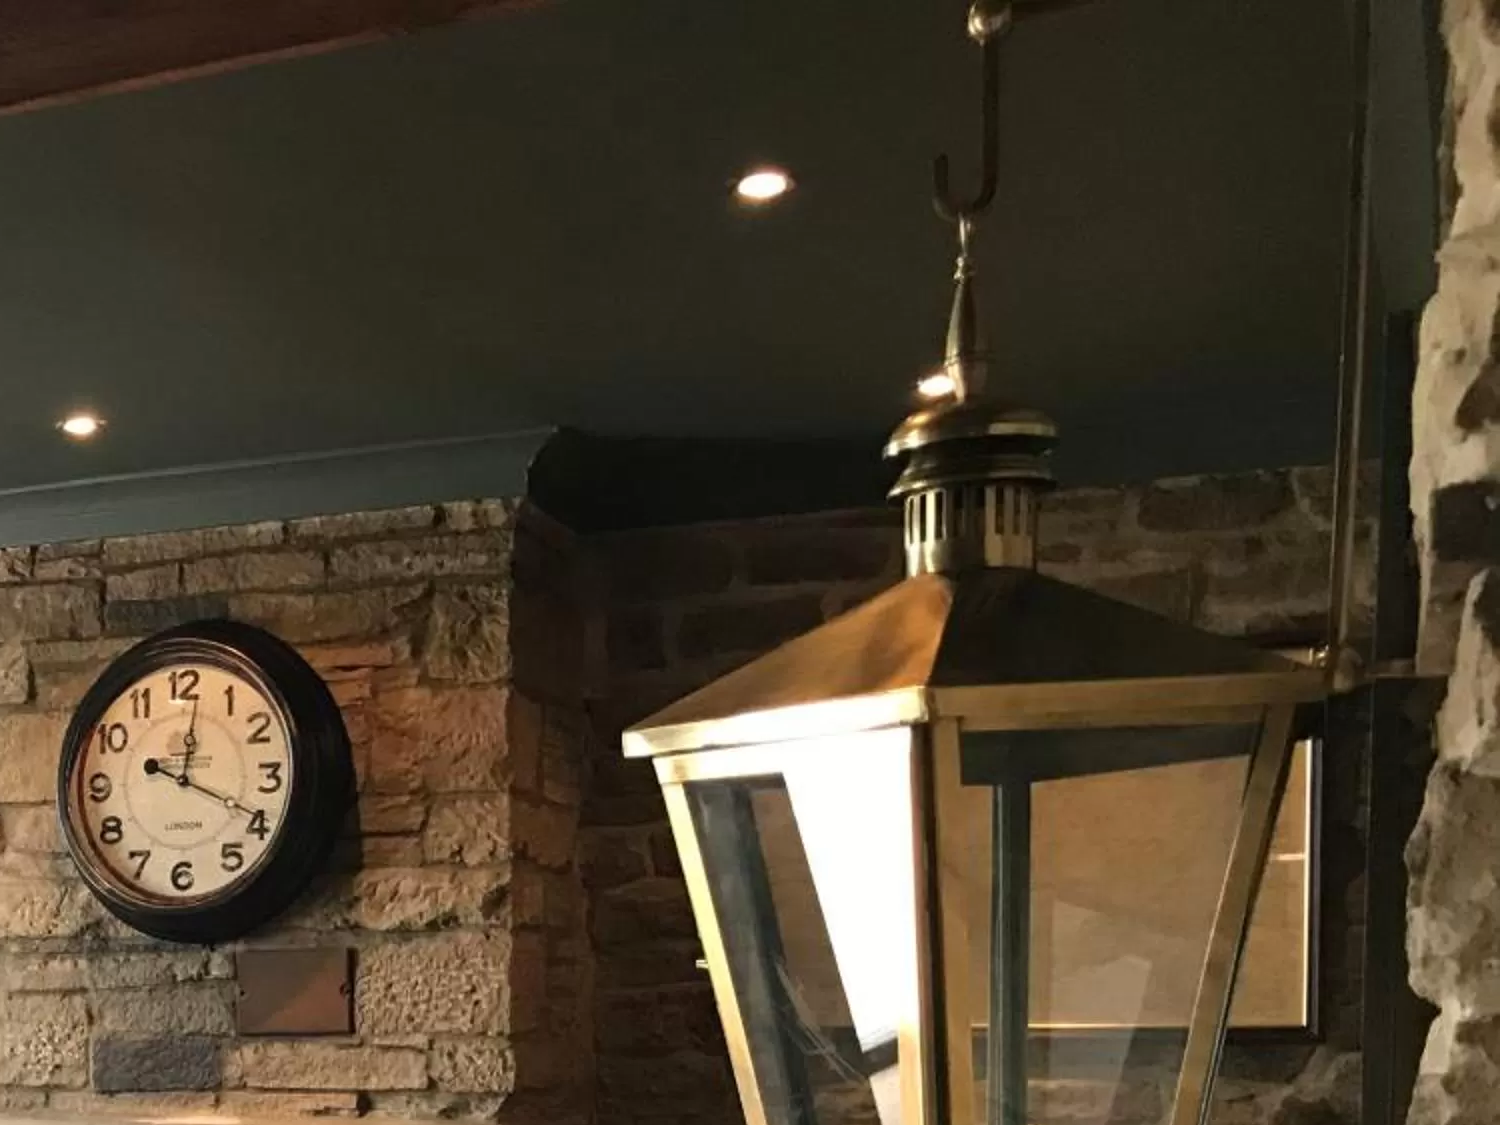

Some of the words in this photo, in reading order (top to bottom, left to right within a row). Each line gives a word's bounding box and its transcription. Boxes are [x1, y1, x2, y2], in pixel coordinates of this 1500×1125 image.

[168, 670, 200, 701] 12
[224, 684, 235, 717] 1
[129, 687, 151, 719] 11
[98, 722, 129, 754] 10
[246, 712, 271, 744] 2
[89, 772, 112, 803] 9
[257, 761, 282, 793] 3
[100, 816, 123, 845] 8
[163, 820, 203, 832] LONDON
[246, 809, 271, 840] 4
[128, 850, 151, 880] 7
[220, 842, 244, 872] 5
[170, 861, 194, 891] 6
